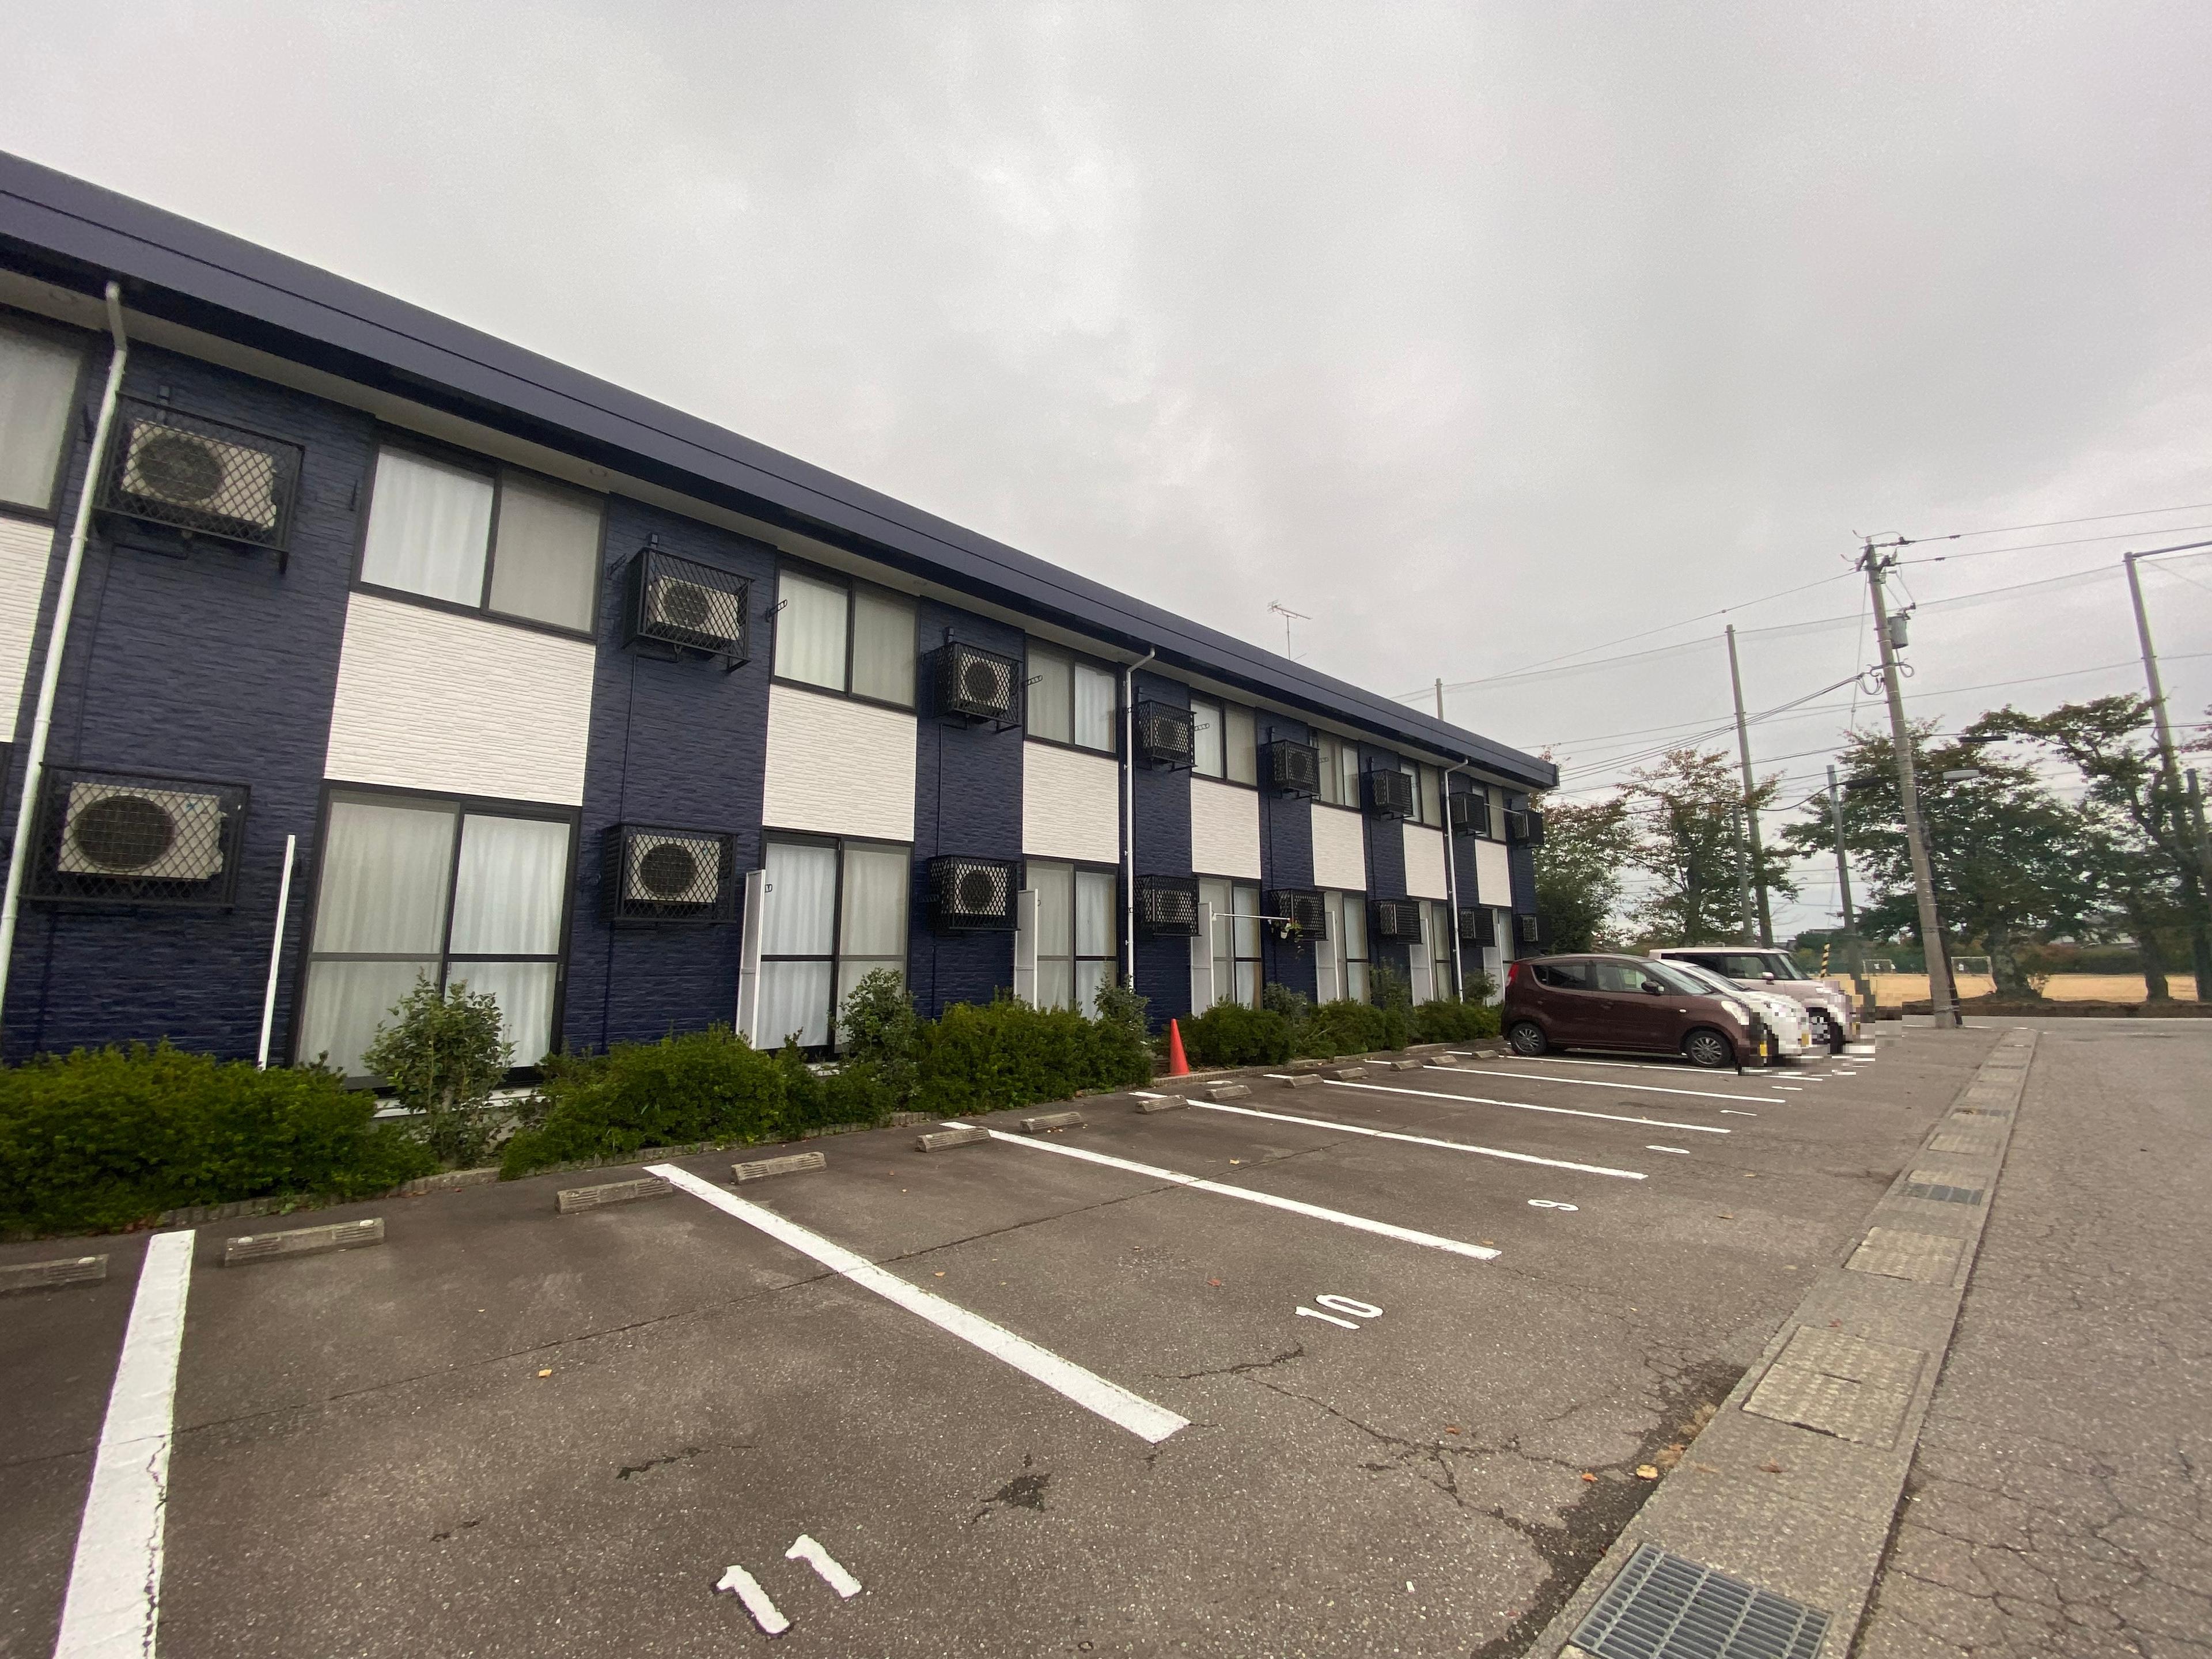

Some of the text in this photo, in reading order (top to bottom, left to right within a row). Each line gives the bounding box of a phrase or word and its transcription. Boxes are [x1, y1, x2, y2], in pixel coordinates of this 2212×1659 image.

[1645, 1145, 1690, 1154] 8
[1527, 1199, 1579, 1211] 9
[1294, 1294, 1384, 1330] 10
[716, 1534, 862, 1634] 11
